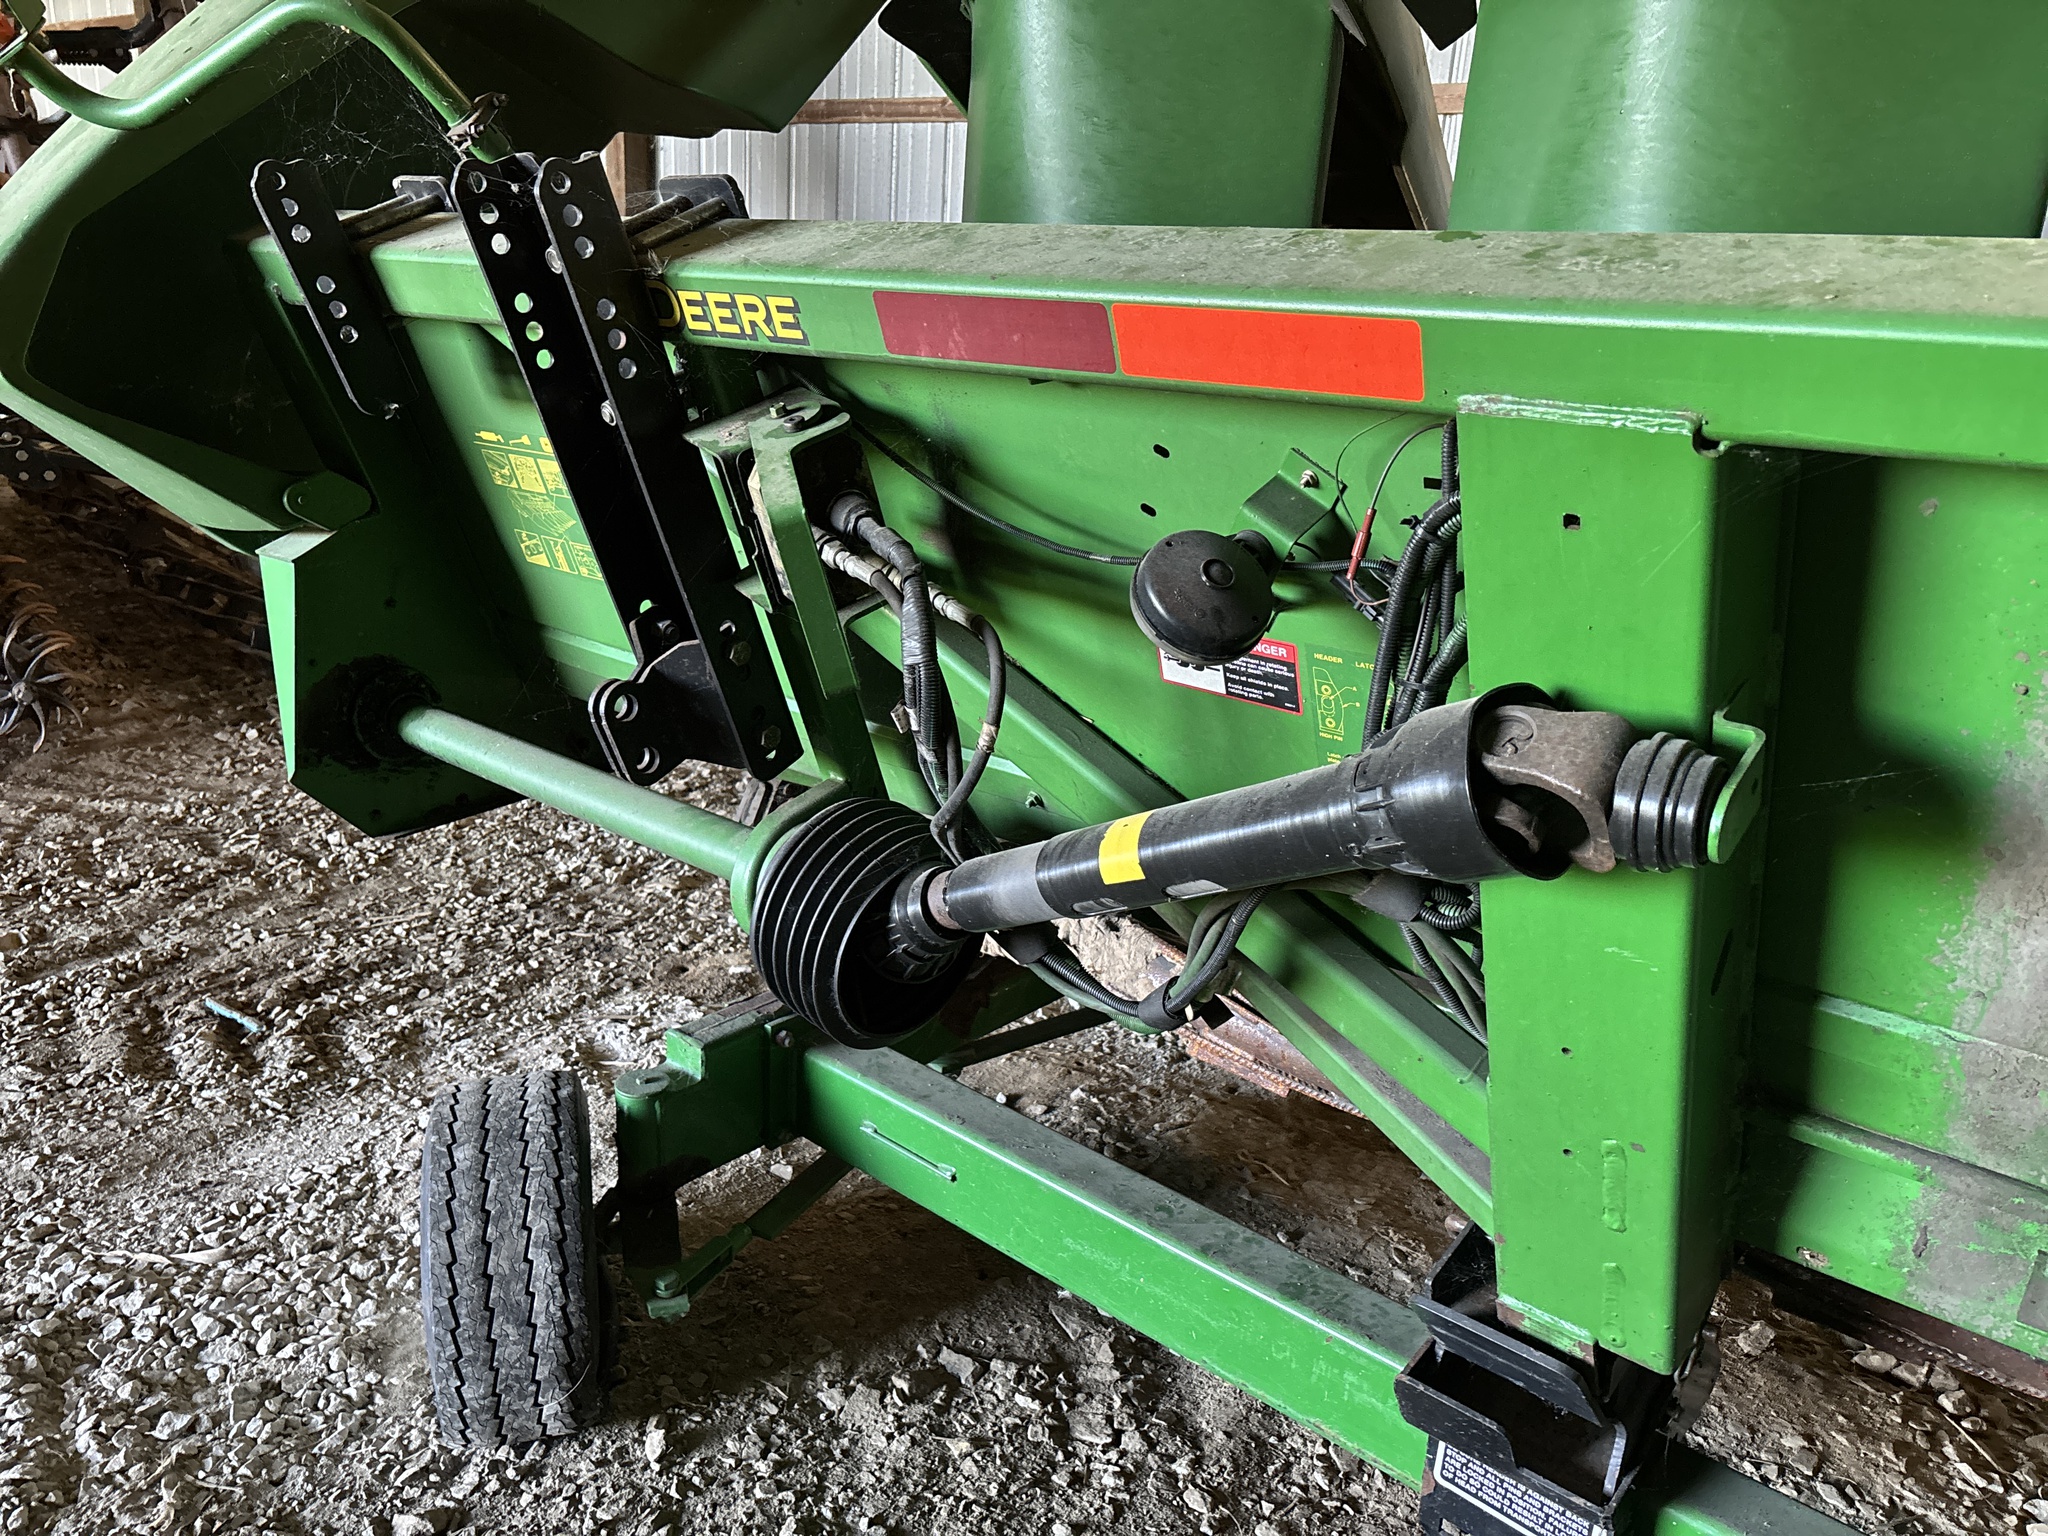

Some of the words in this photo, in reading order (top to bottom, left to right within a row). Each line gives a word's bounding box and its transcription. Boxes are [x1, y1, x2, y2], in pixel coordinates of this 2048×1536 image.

[645, 279, 809, 345] DEERE
[1254, 643, 1287, 658] NGER
[1313, 652, 1343, 664] HEADER
[1355, 661, 1375, 671] LATC
[1226, 672, 1240, 681] Keep
[1247, 677, 1267, 686] shields
[1227, 682, 1243, 690] Avoid
[1243, 686, 1263, 695] contact
[1442, 1469, 1455, 1480] OF
[1454, 1476, 1477, 1493] HEAD
[1477, 1491, 1502, 1509] FROM
[1444, 1455, 1462, 1470] ARE
[1462, 1465, 1495, 1489] LOCKED
[1496, 1485, 1506, 1496] IN
[1506, 1492, 1547, 1520] POSITION.
[1548, 1516, 1583, 1536] FAILUR
[1444, 1461, 1455, 1473] TO
[1455, 1470, 1468, 1481] DO
[1469, 1477, 1481, 1489] SO
[1482, 1485, 1511, 1506] COULD
[1511, 1502, 1545, 1526] RESULT
[1545, 1522, 1554, 1533] IN
[1446, 1448, 1468, 1463] STOP
[1467, 1461, 1486, 1475] AND
[1485, 1473, 1502, 1487] ALL
[1502, 1481, 1522, 1498] PINS
[1523, 1494, 1541, 1509] AND
[1542, 1505, 1589, 1536] BRACKETS
[1526, 1488, 1565, 1513] AGAINST
[1565, 1510, 1589, 1529] BACK
